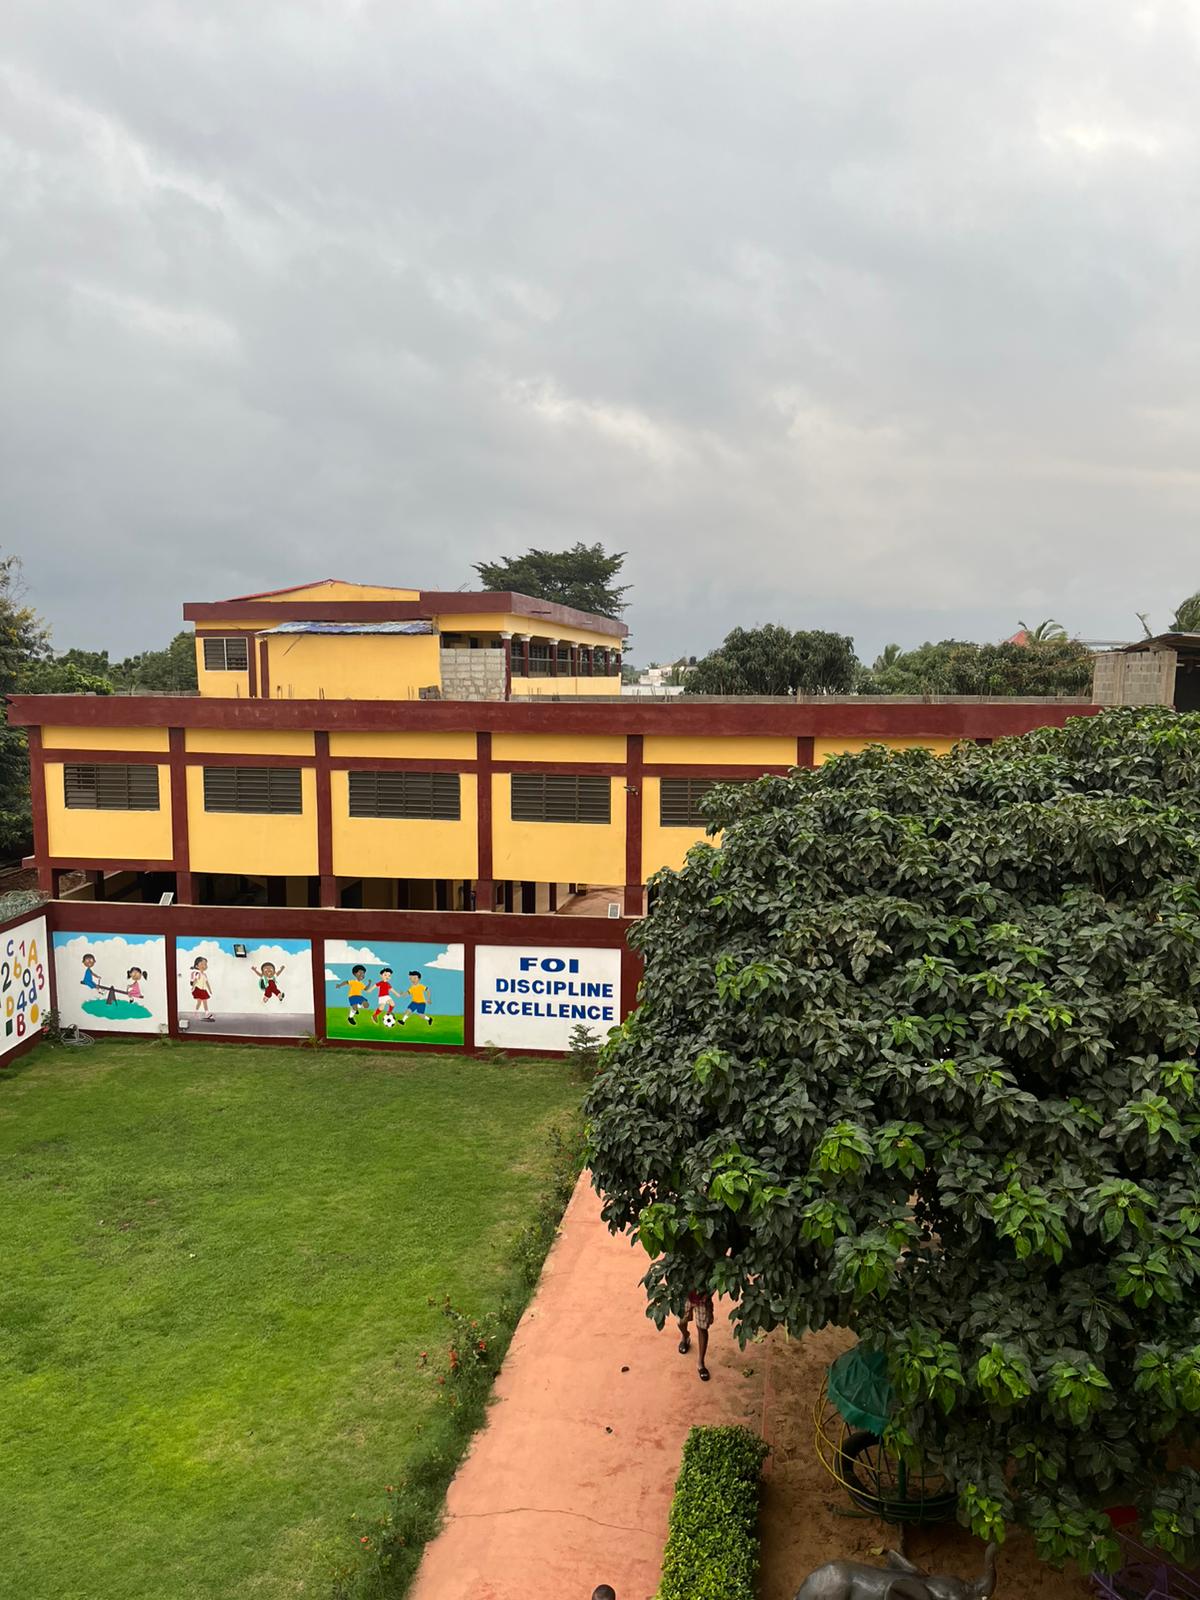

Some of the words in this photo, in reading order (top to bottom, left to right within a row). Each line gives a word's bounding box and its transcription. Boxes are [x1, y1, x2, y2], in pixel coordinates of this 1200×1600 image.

[19, 940, 25, 957] 1
[28, 939, 38, 967] A
[520, 957, 579, 973] FOI
[1, 962, 12, 992] 2
[36, 964, 44, 990] 3
[496, 978, 613, 998] DISCIPLINE
[6, 996, 14, 1017] D
[17, 990, 27, 1011] 4
[481, 1000, 614, 1021] EXCELLENCE
[16, 1013, 26, 1037] B
